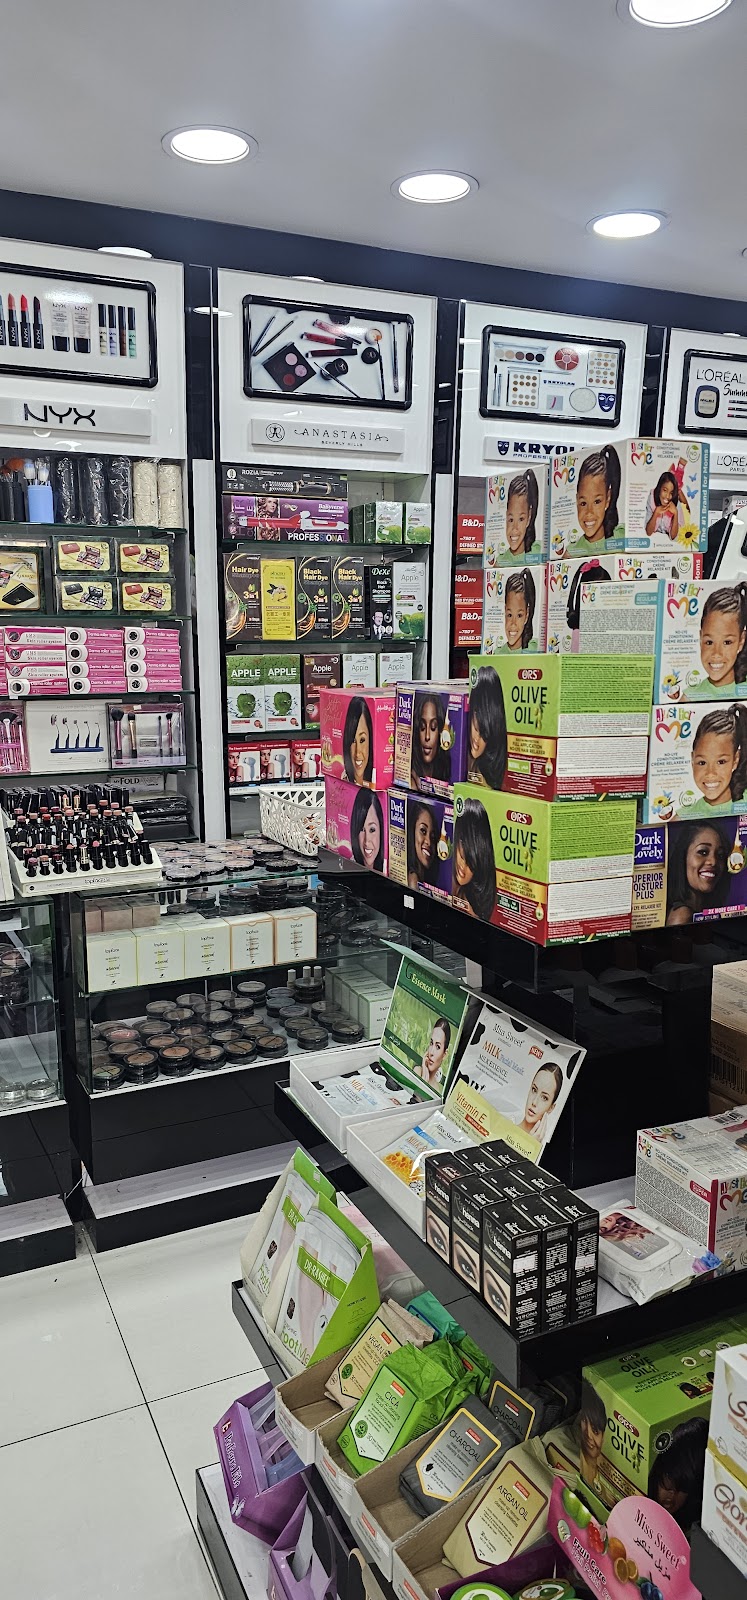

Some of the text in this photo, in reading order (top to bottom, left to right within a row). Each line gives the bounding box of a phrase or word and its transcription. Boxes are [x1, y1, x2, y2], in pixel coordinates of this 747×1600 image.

[23, 402, 96, 427] NYX
[295, 427, 389, 442] ANASTASIA
[701, 488, 709, 515] Brand
[231, 669, 261, 678] APPLE
[268, 667, 297, 677] APPLE
[312, 664, 332, 674] Apple
[511, 685, 548, 705] OLIVE
[514, 706, 534, 725] OIL
[120, 777, 140, 785] FOLD
[499, 825, 538, 850] OLIVE
[503, 845, 524, 867] OIL
[633, 872, 663, 883] UPERIOR
[633, 881, 663, 891] OISTURE
[636, 890, 655, 900] PLUS
[411, 973, 431, 994] Essence
[431, 986, 447, 1005] Mask
[493, 1023, 525, 1047] Miss Sweet
[482, 1040, 502, 1060] MILK
[456, 1091, 480, 1116] Vitamin
[479, 1112, 487, 1124] E
[434, 1182, 450, 1202] henna
[462, 1206, 480, 1229] henna
[493, 1235, 512, 1260] henna
[368, 1333, 385, 1353] VEGAN
[620, 1356, 651, 1373] OLIVE
[384, 1391, 400, 1409] CICA
[493, 1405, 524, 1436] CHARCOAL
[449, 1429, 481, 1462] CHARCOAL
[607, 1417, 645, 1461] OLIVE
[611, 1436, 632, 1463] OIL
[497, 1485, 529, 1522] ARGAN OIL
[634, 1508, 680, 1570] Miss Sweet
[573, 1536, 607, 1585] Fruit Care
